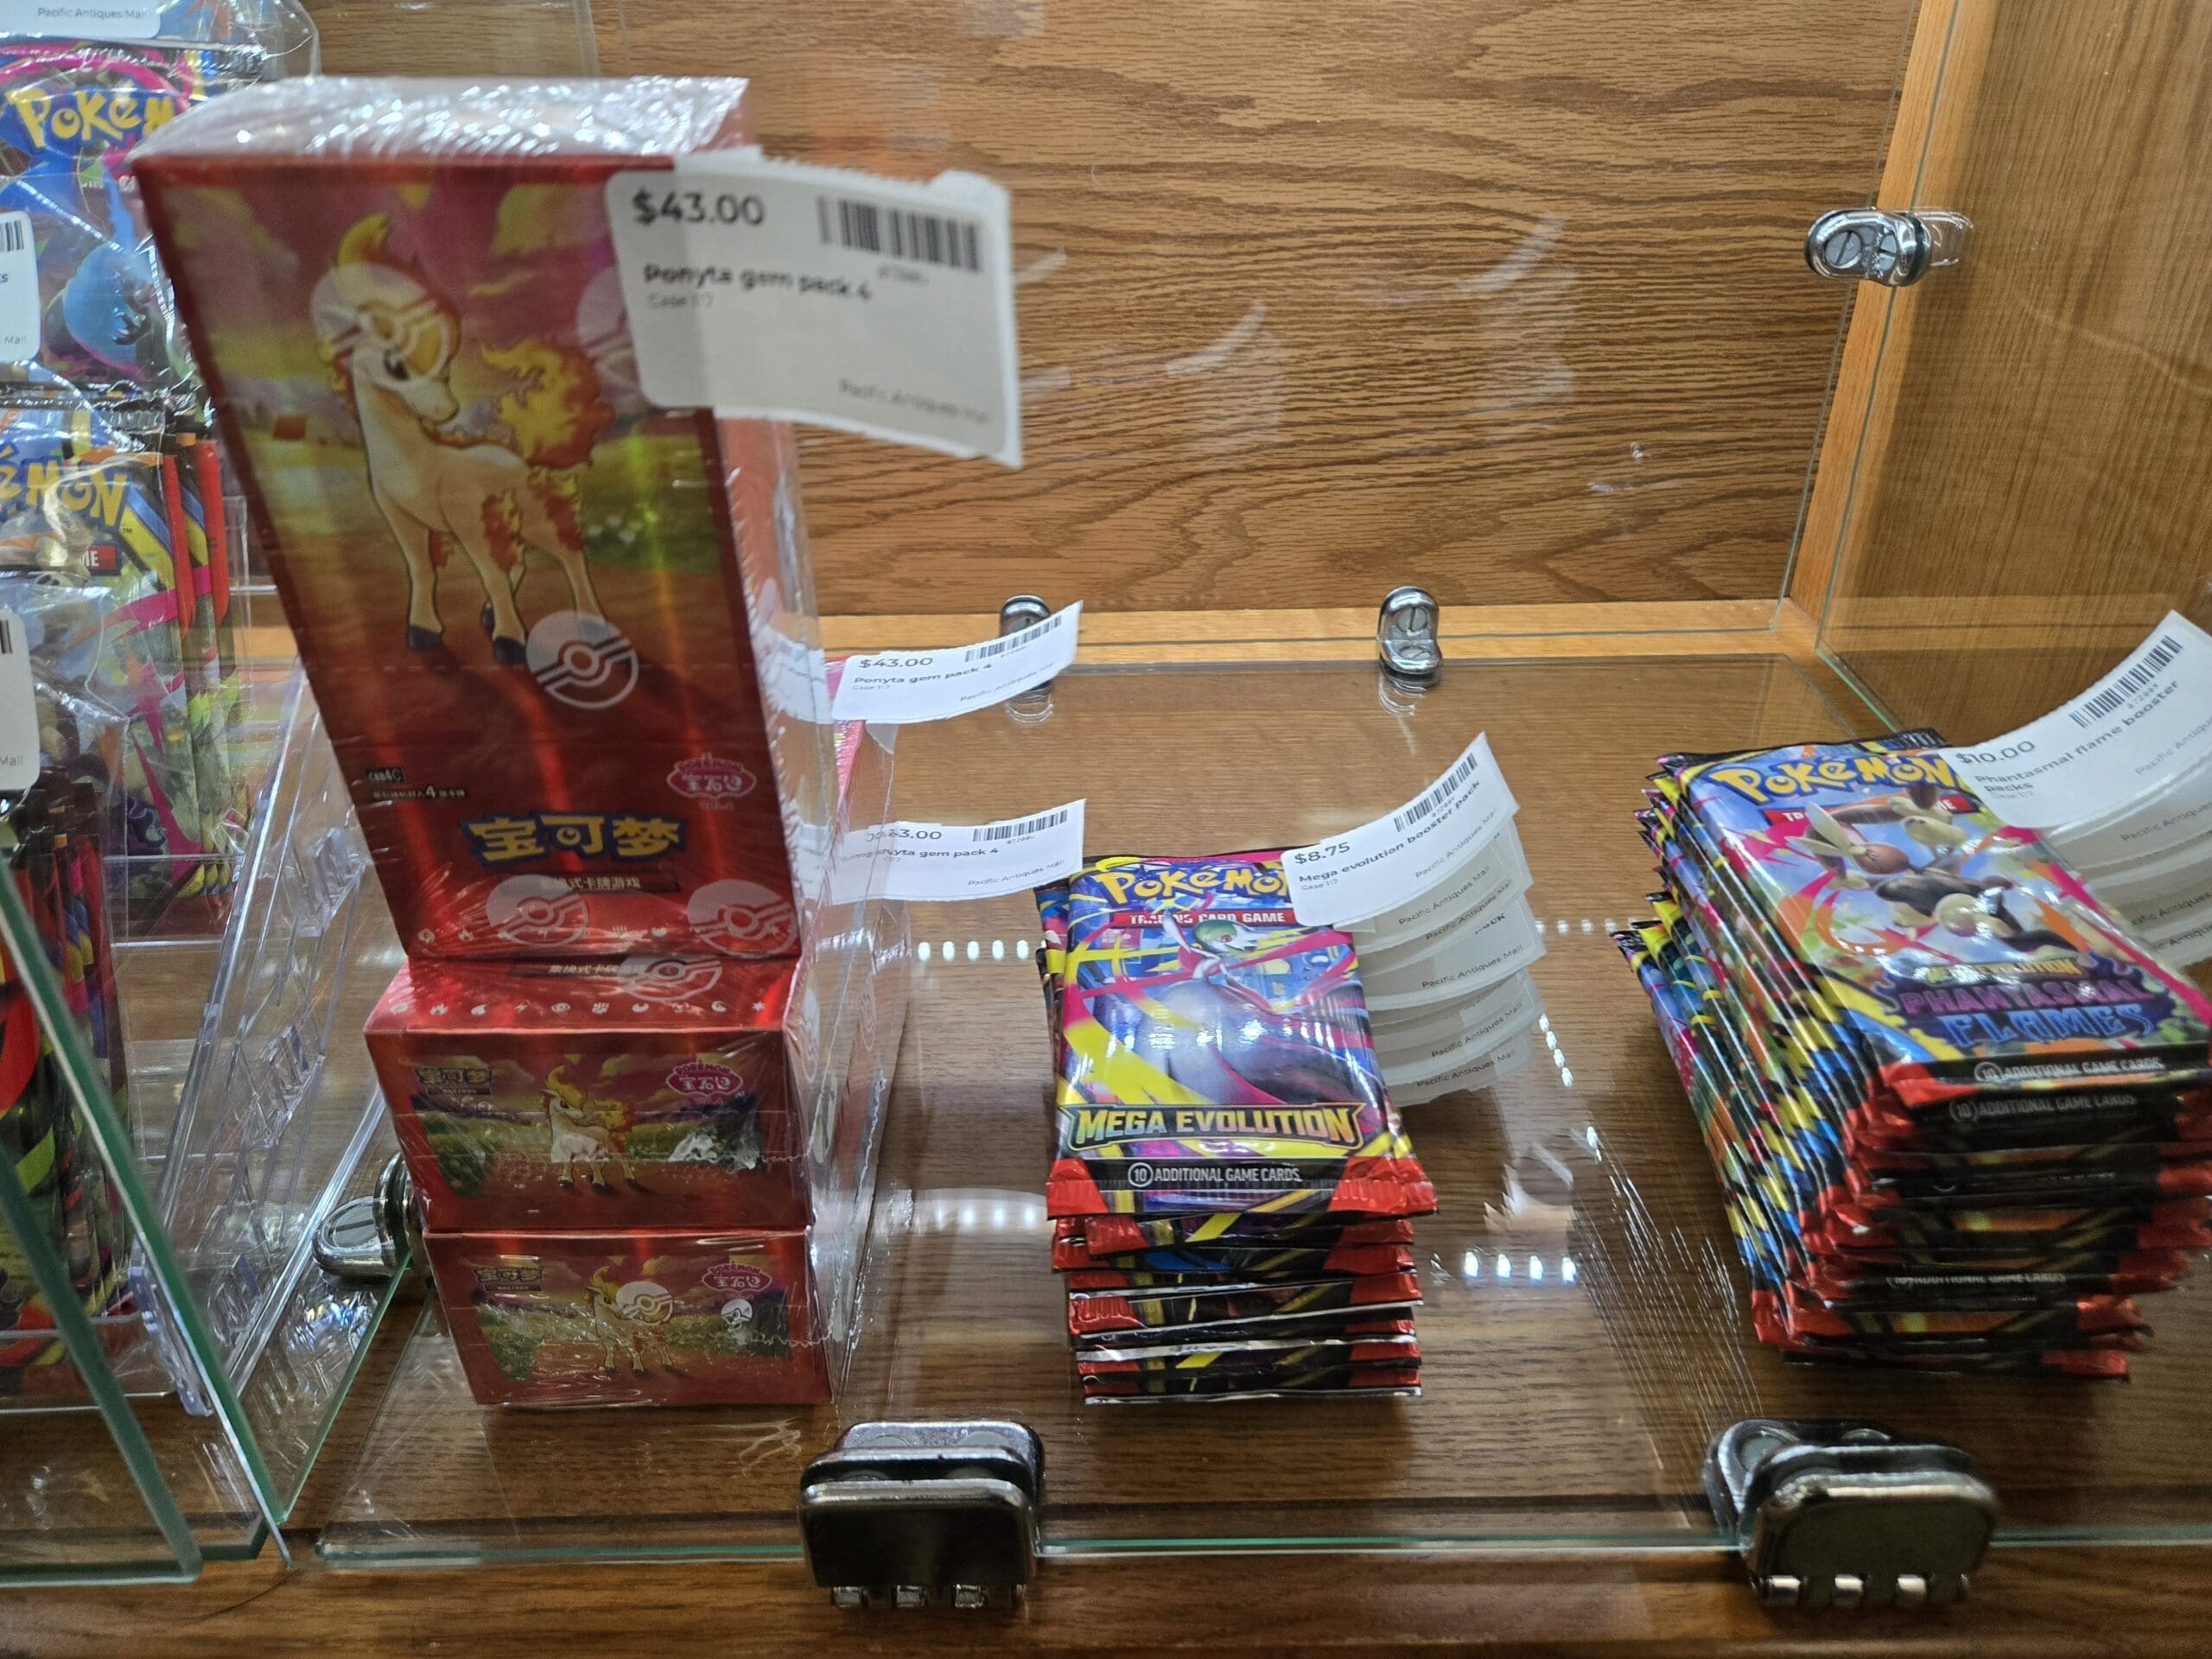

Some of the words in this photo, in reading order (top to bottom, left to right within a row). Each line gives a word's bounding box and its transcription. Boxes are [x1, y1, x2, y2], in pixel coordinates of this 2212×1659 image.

[38, 8, 73, 17] Pacific
[75, 8, 122, 20] Antiques
[126, 9, 147, 19] Mall
[5, 79, 174, 148] POKéM
[632, 187, 765, 226] $43.00
[644, 263, 733, 289] Ponyta
[4, 335, 27, 345] Mall
[857, 658, 933, 669] $43.00
[909, 674, 941, 683] gem
[945, 666, 978, 679] pack
[1974, 752, 2074, 783] Phantasmal
[2075, 726, 2122, 755] flame
[2122, 680, 2178, 726] booster
[2176, 715, 2212, 749] Antiqu
[1955, 741, 2035, 764] $10.00
[468, 814, 681, 861] 宝可梦
[1299, 869, 1338, 882] Mega
[1341, 842, 1404, 873] evolution
[1407, 808, 1452, 843] booster
[1455, 779, 1480, 810] pack
[2120, 823, 2161, 842] Pacific
[953, 849, 987, 858] pack
[1294, 842, 1351, 865] $8.75
[1415, 857, 1445, 879] Pacific
[1446, 824, 1483, 857] Antiques
[968, 877, 1000, 886] Pacific
[1001, 867, 1044, 882] Antiques
[1301, 882, 1325, 891] Case
[1398, 907, 1432, 925] Pacific
[1433, 881, 1473, 911] Antiques
[1472, 864, 1491, 883] Mall
[1242, 912, 1286, 923] GAME
[1426, 920, 1457, 941] Pacific
[1458, 894, 1497, 925] Antiques
[2132, 913, 2158, 927] cific
[2168, 923, 2212, 947] Antiqu
[1421, 975, 1456, 988] Pacific
[1458, 957, 1502, 979] Antiques
[1503, 944, 1523, 959] Mall
[1431, 1040, 1463, 1058] Pacific
[1465, 1016, 1504, 1044] Antiques
[1504, 1001, 1522, 1019] Mall
[1936, 1003, 2158, 1049] FLAMES
[1416, 1073, 1450, 1087] Pacific
[1452, 1058, 1496, 1079] Antiques
[2003, 1064, 2082, 1079] ADDITIONAL
[2082, 1060, 2120, 1074] GAME
[1978, 1097, 2055, 1116] ADDITIONAL
[2056, 1096, 2092, 1110] GAME
[1076, 1109, 1167, 1145] MEGA
[1176, 1108, 1357, 1144] EVOLUTION
[1154, 1168, 1224, 1182] ADDITIONAL
[1225, 1168, 1260, 1182] GAME
[1261, 1167, 1303, 1183] CARDS
